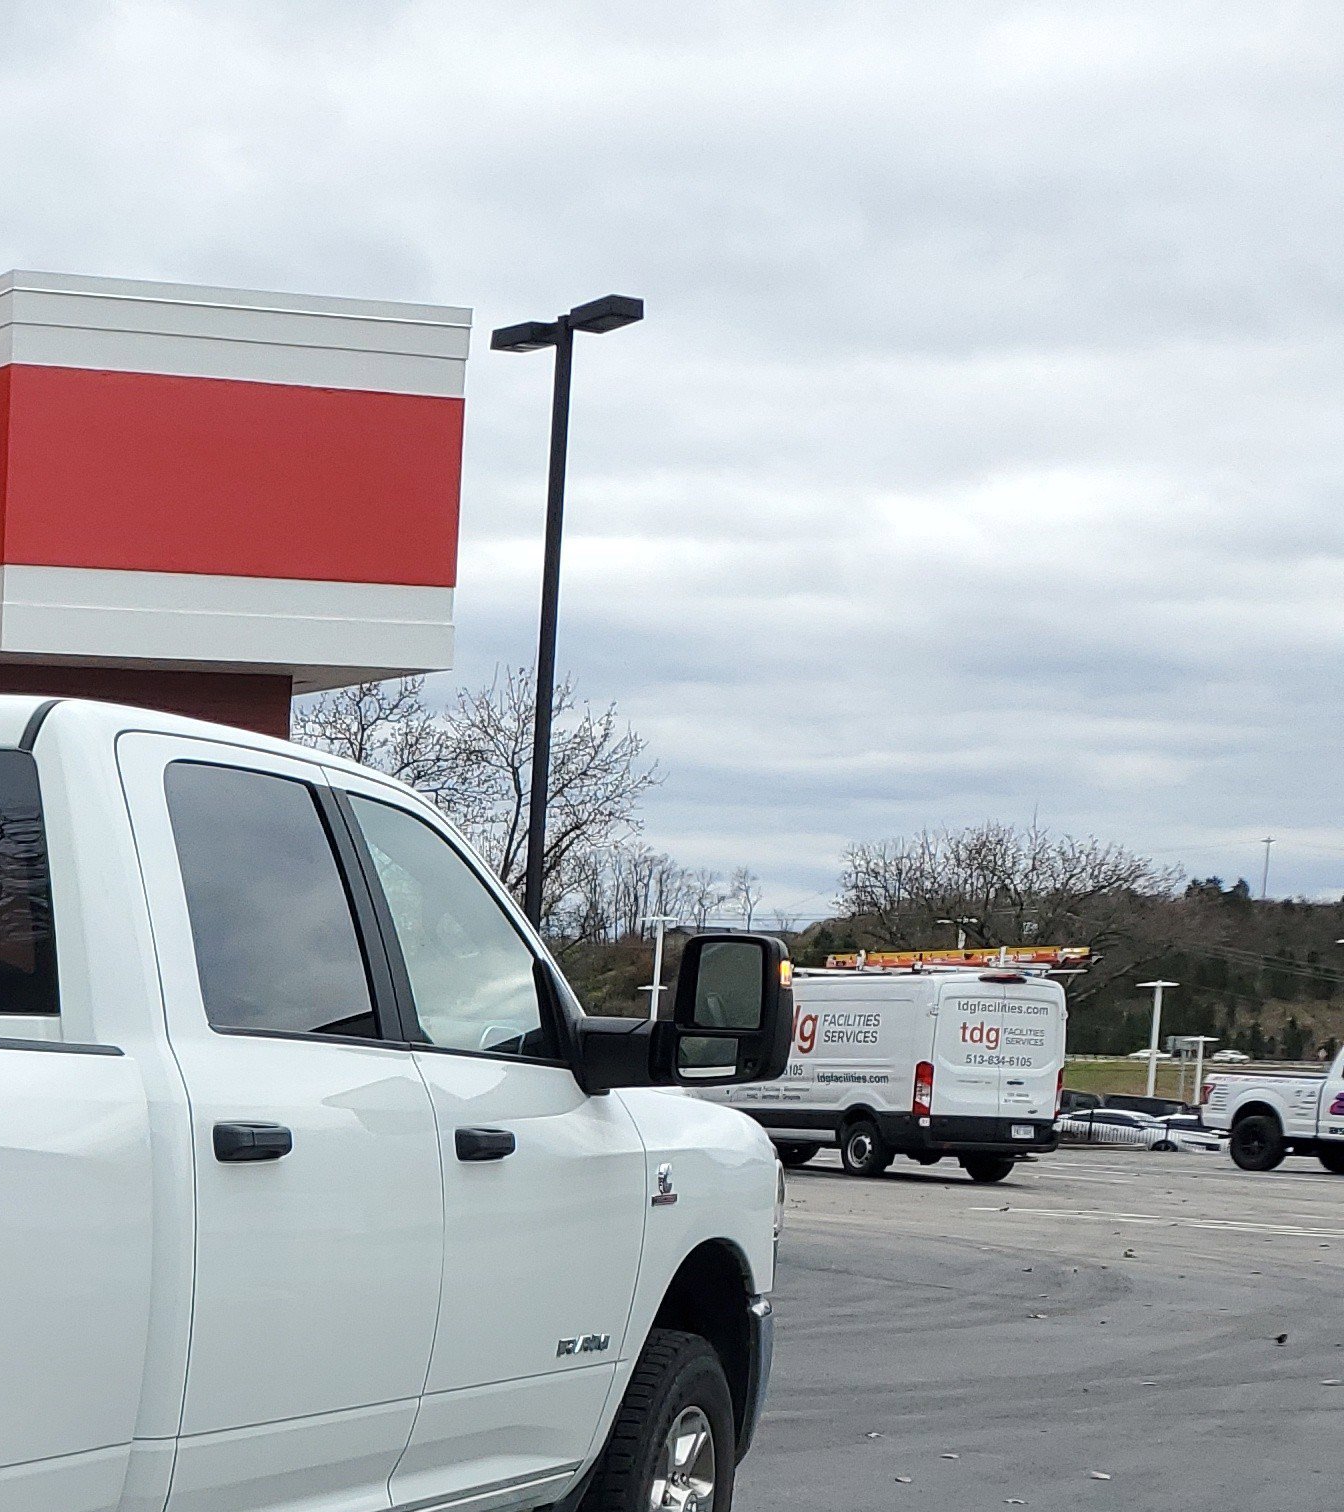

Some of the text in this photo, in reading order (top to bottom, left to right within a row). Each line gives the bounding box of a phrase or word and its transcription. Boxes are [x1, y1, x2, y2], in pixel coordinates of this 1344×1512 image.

[957, 1001, 1049, 1015] tdgfacilities.com
[822, 1014, 881, 1027] FACILITIES
[823, 1030, 878, 1043] SERVICES
[960, 1021, 1001, 1050] tdg
[817, 1073, 889, 1086] tdgfacilities.com
